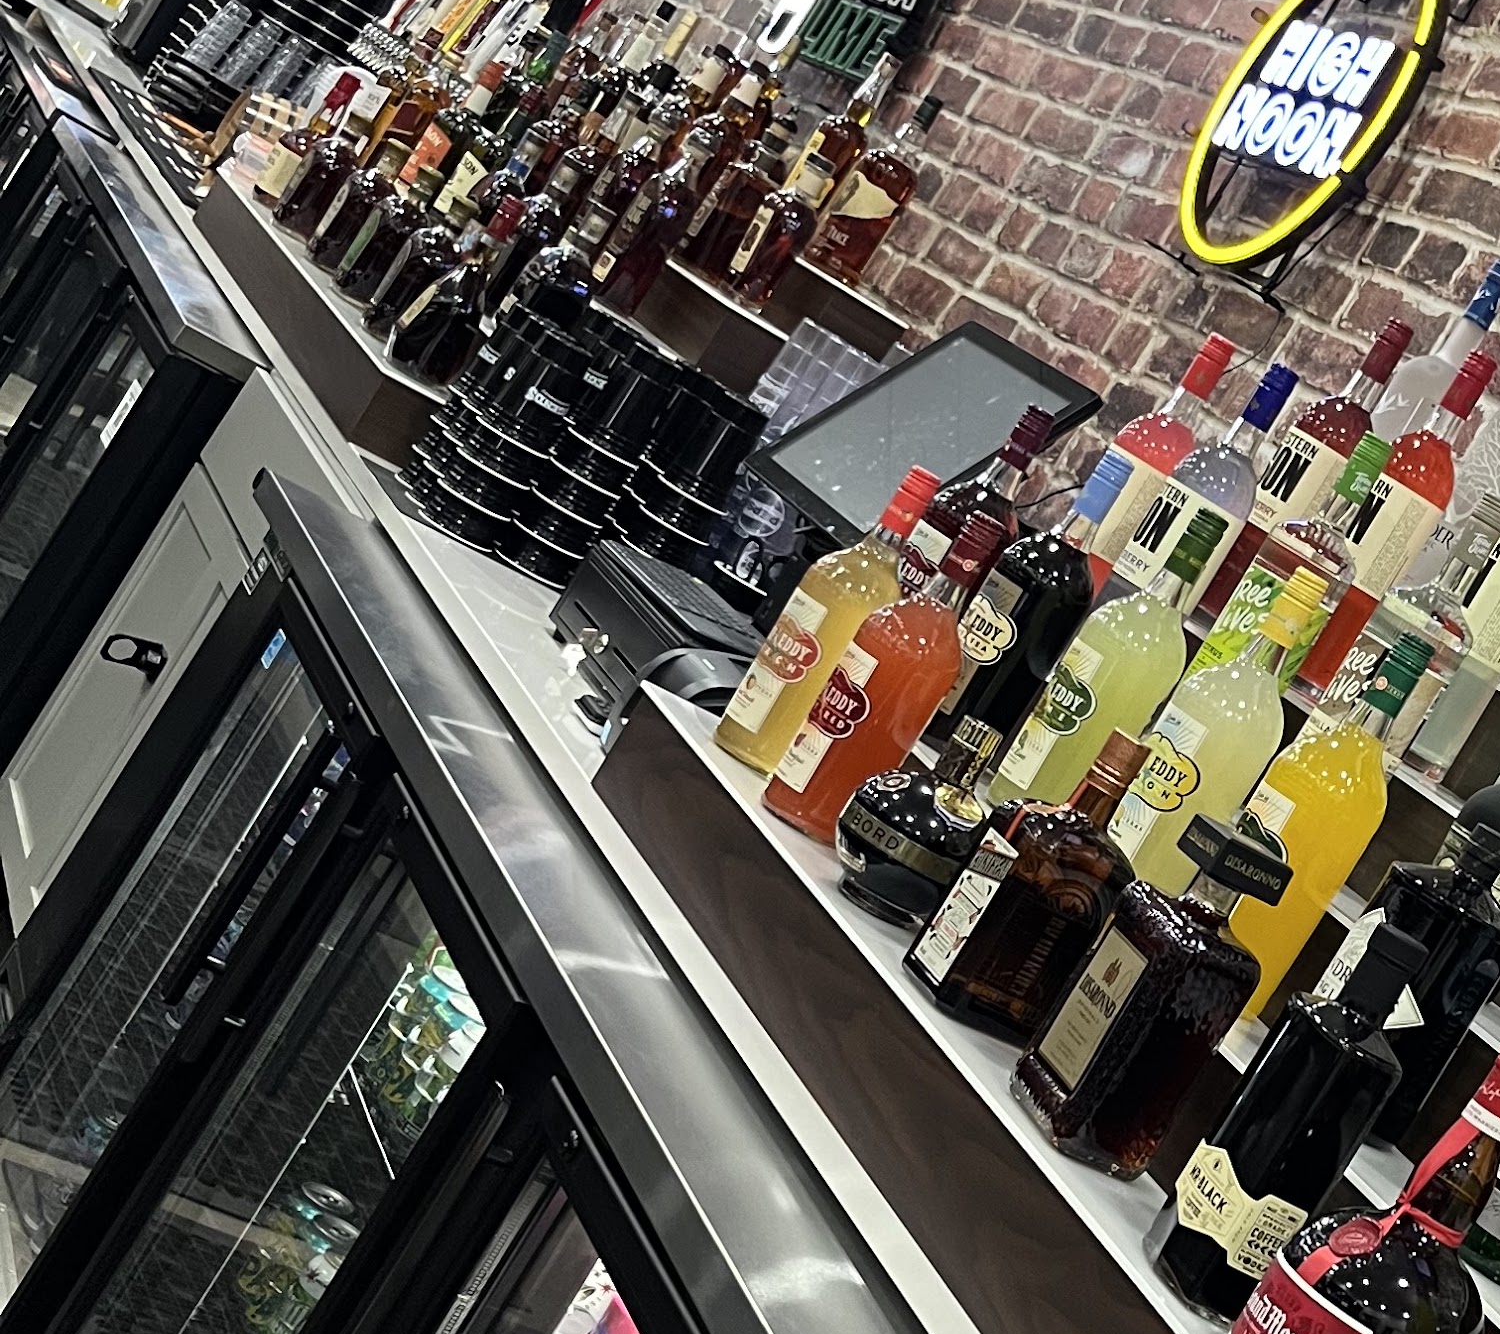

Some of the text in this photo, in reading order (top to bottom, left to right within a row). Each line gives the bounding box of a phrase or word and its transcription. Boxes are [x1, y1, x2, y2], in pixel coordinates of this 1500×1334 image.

[1260, 19, 1397, 107] HIGH
[1212, 83, 1363, 179] NOON
[971, 613, 1006, 643] EDDY
[776, 632, 813, 662] EDDY
[825, 686, 859, 715] EDDY
[1051, 682, 1085, 713] EDDY
[823, 712, 844, 730] RED
[1149, 755, 1188, 788] EDDY
[1223, 853, 1283, 892] DISARONNO
[1197, 1176, 1228, 1215] BLACK
